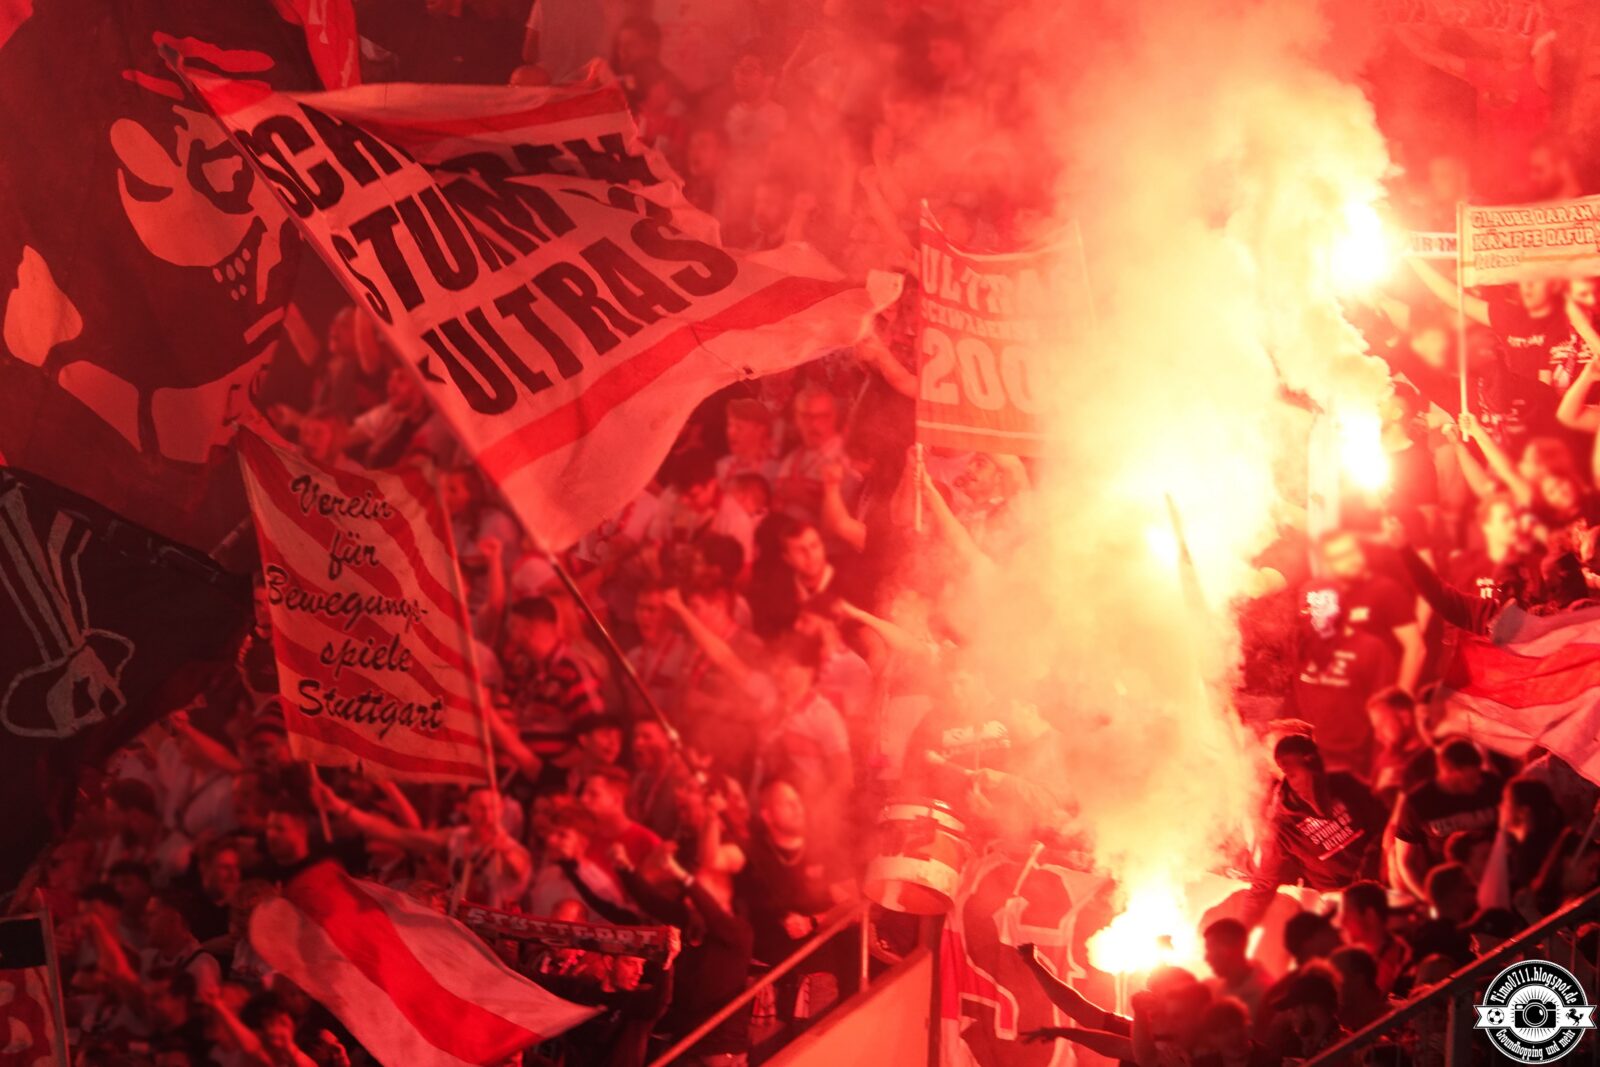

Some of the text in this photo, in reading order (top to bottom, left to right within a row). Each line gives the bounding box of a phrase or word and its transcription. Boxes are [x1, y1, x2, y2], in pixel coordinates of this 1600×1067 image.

[1472, 228, 1544, 251] KÄMPFE
[1545, 222, 1595, 247] DAFÜR
[1534, 204, 1593, 225] DARAN
[420, 213, 738, 416] ULTRAS
[290, 474, 393, 519] Verein
[327, 529, 380, 581] für
[319, 634, 412, 679] spiele
[297, 679, 444, 740] Stuttgart
